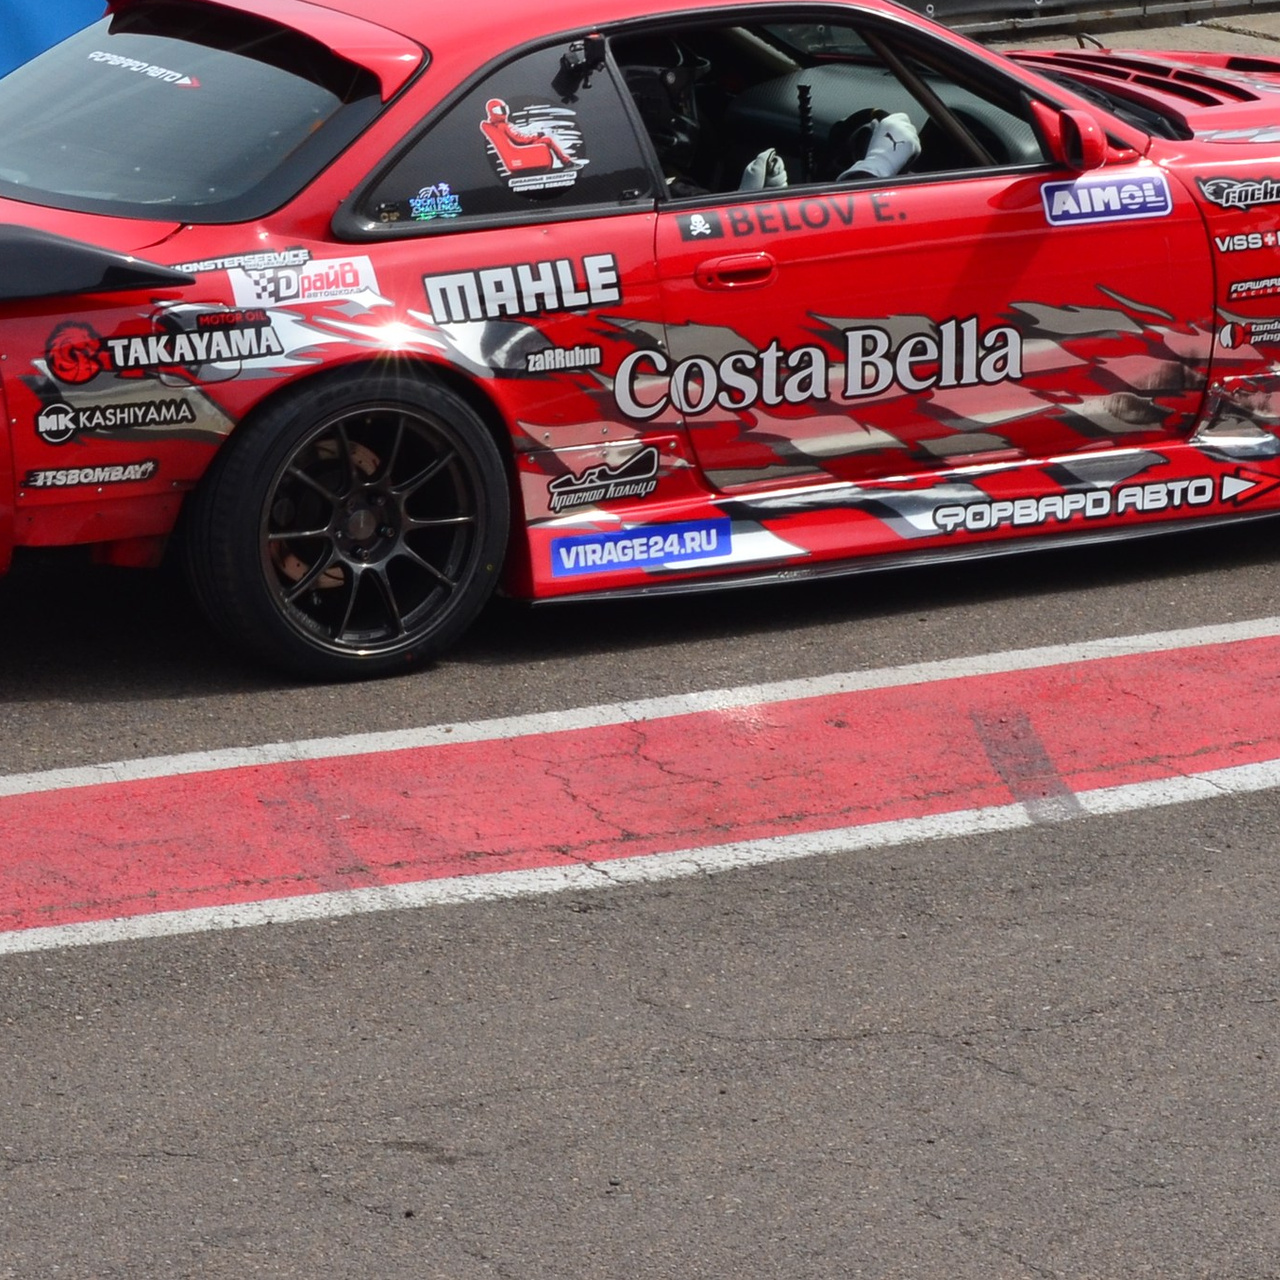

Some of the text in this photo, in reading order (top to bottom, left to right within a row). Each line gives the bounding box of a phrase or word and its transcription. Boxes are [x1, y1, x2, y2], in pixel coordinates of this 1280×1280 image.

[726, 192, 907, 238] BELOV E.
[1051, 183, 1165, 216] AIMOL
[424, 254, 620, 323] MAHLE
[199, 310, 268, 326] MOTOR OIL
[107, 326, 284, 367] TAKAYAMA
[613, 317, 1023, 418] Costa Bella
[38, 401, 193, 433] MK KASHIYAMA
[559, 529, 718, 569] VIRAGE24.RU
